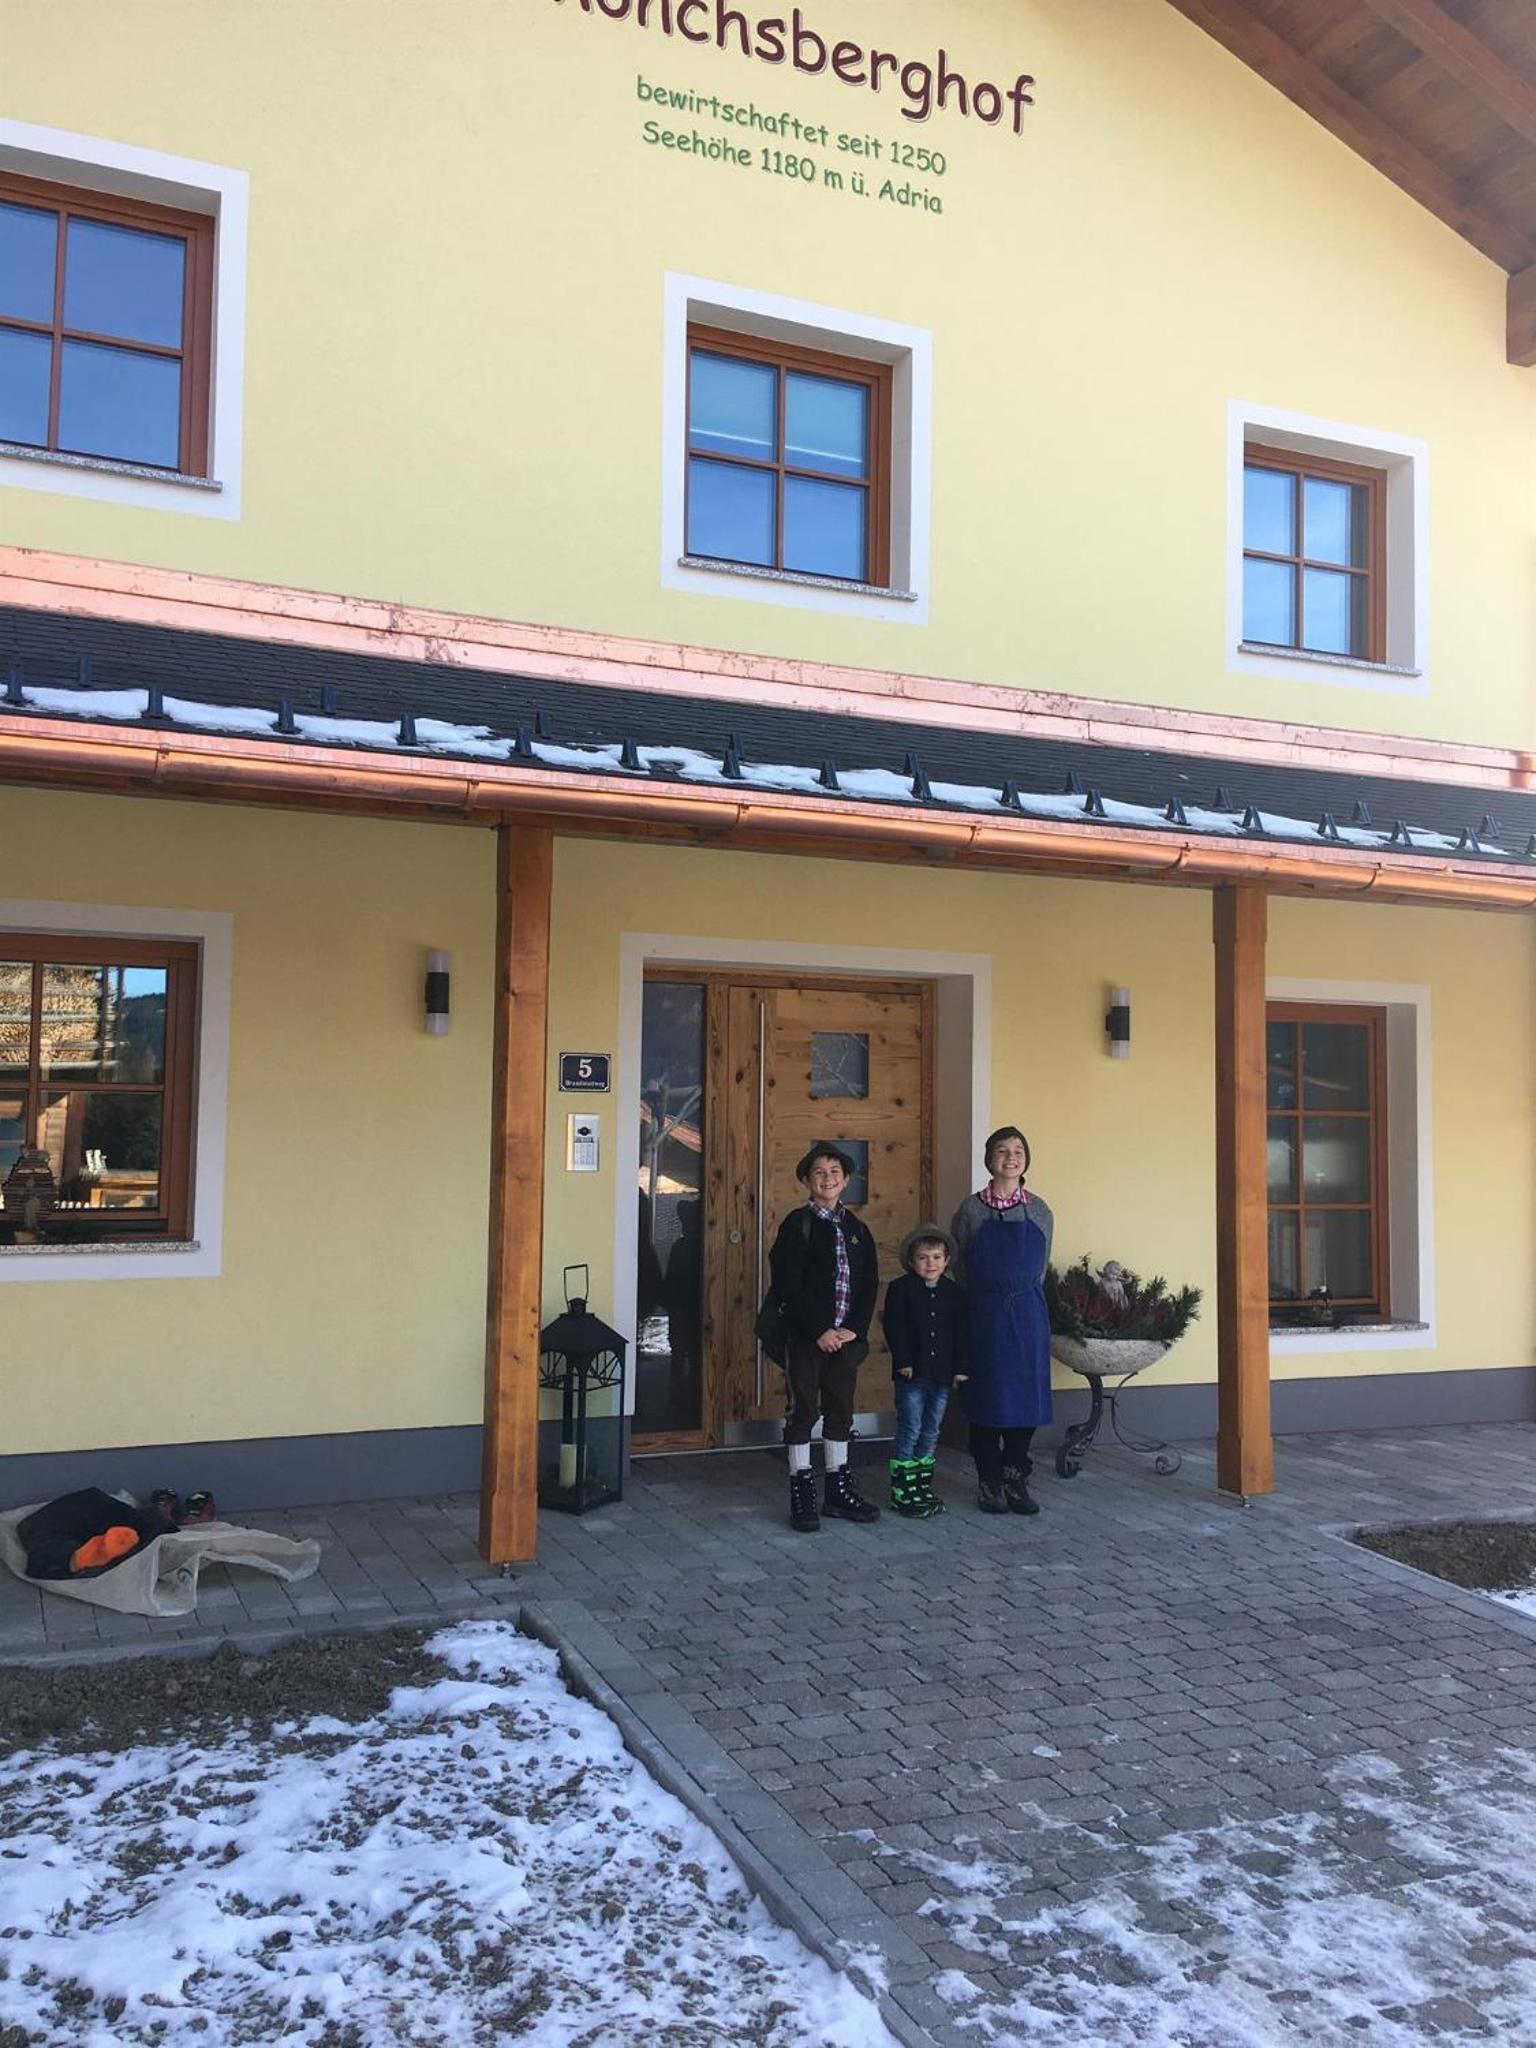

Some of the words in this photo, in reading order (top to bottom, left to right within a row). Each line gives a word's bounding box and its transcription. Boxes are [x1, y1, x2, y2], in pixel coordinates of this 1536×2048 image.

[553, 0, 1036, 135] nchsberghof
[636, 74, 829, 147] bewirtschaftet
[836, 133, 883, 160] seit
[889, 141, 947, 176] 1250
[642, 120, 753, 167] Seehöhe
[761, 147, 816, 183] 1180
[824, 168, 844, 191] m
[878, 179, 943, 215] Adria
[579, 1059, 592, 1078] 5
